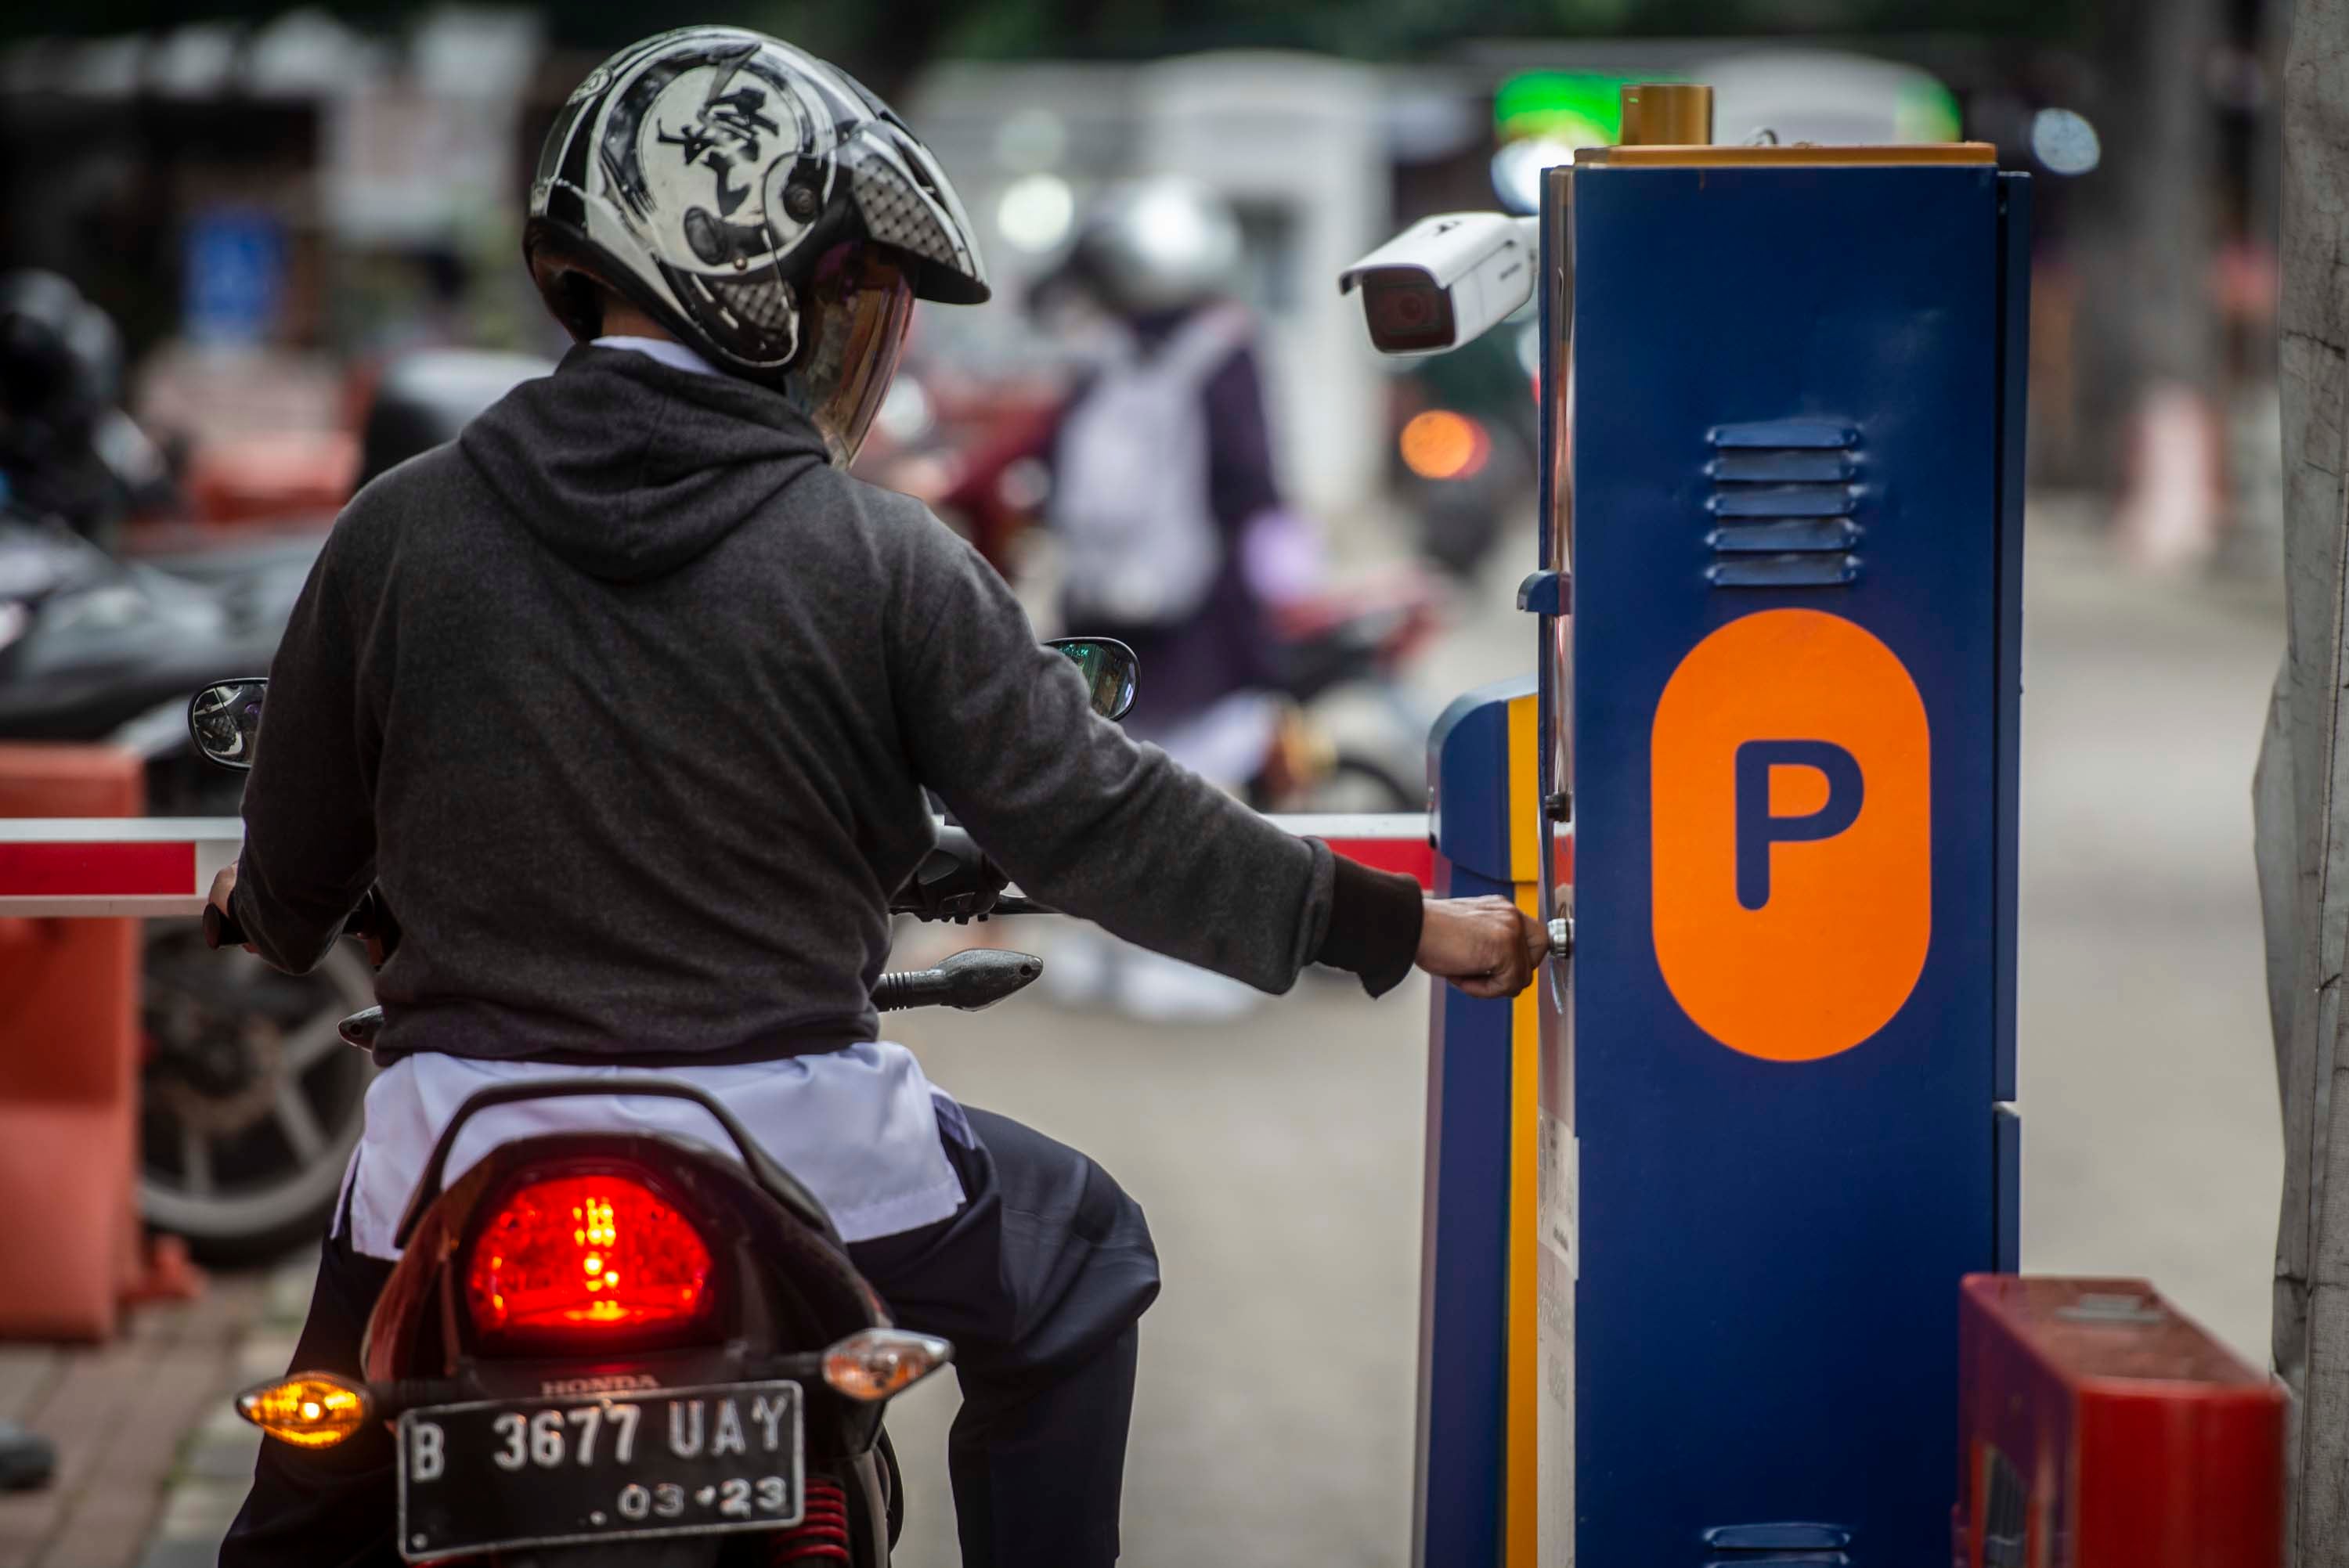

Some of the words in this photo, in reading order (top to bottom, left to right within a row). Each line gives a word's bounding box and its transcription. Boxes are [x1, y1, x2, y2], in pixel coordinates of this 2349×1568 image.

[1734, 738, 1864, 910] P
[541, 1375, 660, 1396] HONDA
[411, 1422, 445, 1482] B
[493, 1403, 640, 1470] 3677
[669, 1395, 788, 1458] UAY
